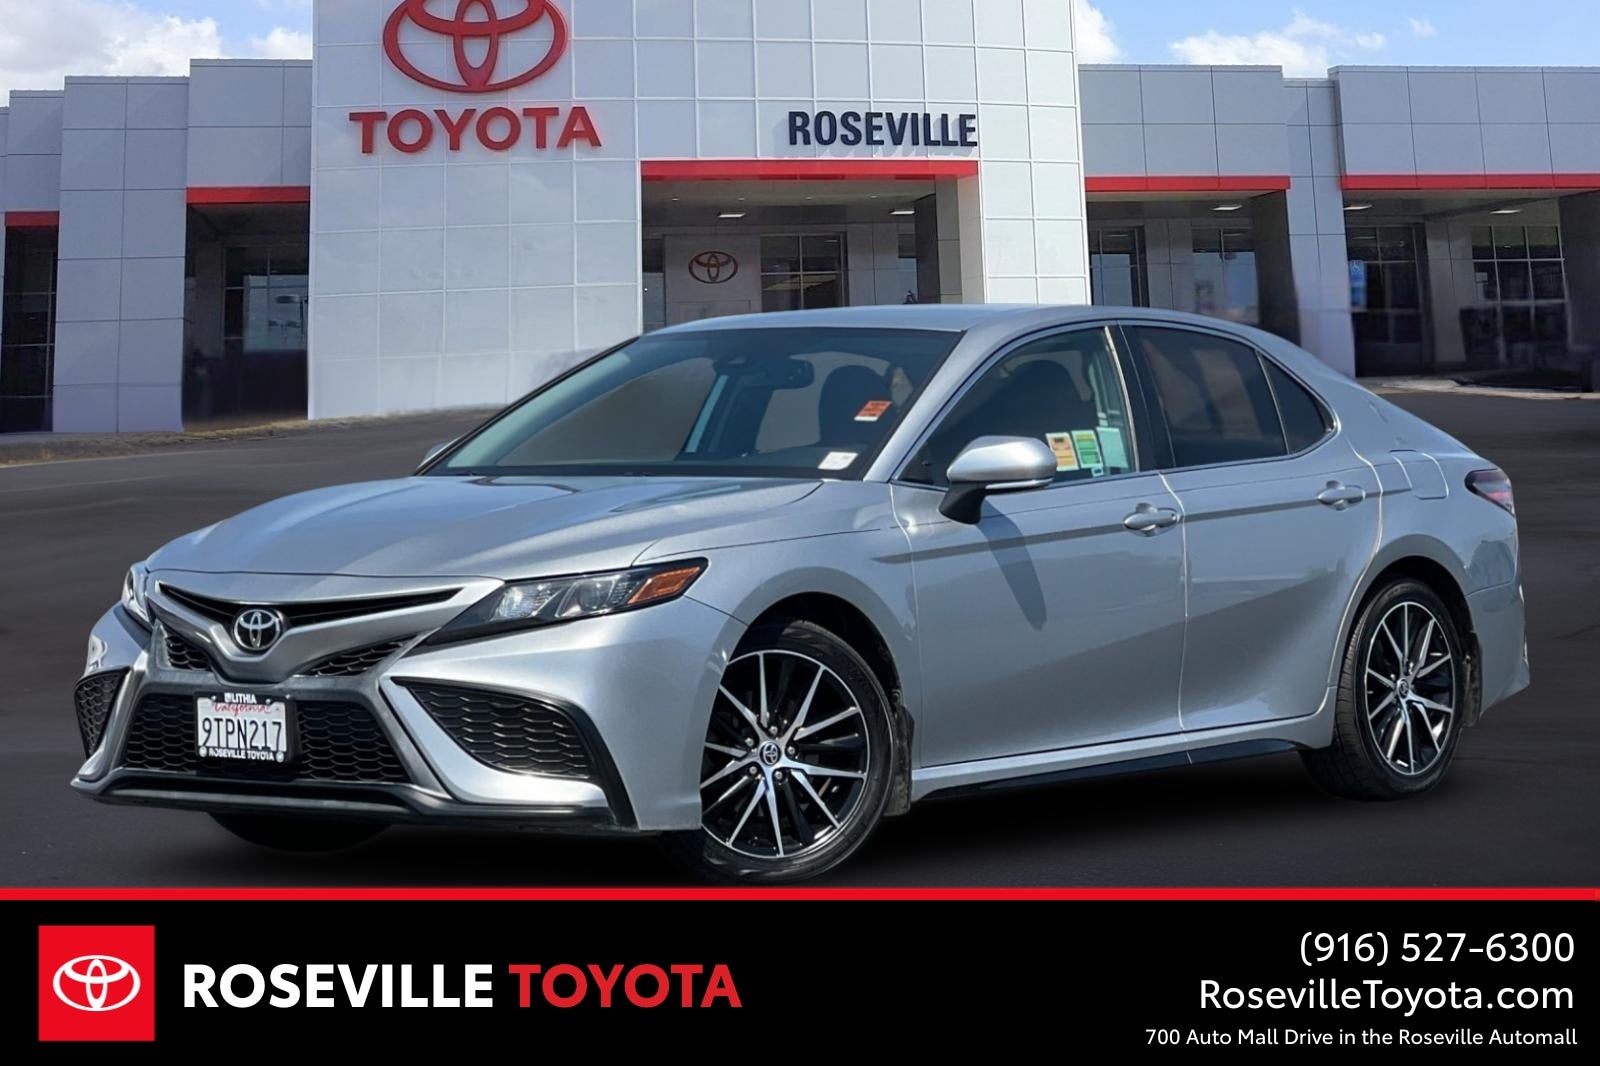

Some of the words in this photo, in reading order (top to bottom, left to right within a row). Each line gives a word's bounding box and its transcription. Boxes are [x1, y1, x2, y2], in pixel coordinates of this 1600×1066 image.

[349, 106, 602, 154] TOYOTA
[788, 110, 979, 148] ROSEVILLE
[231, 693, 256, 704] LITHIA
[202, 717, 282, 752] 9TPN217
[209, 748, 246, 759] ROSEVILLE
[247, 751, 274, 760] TOYOTA
